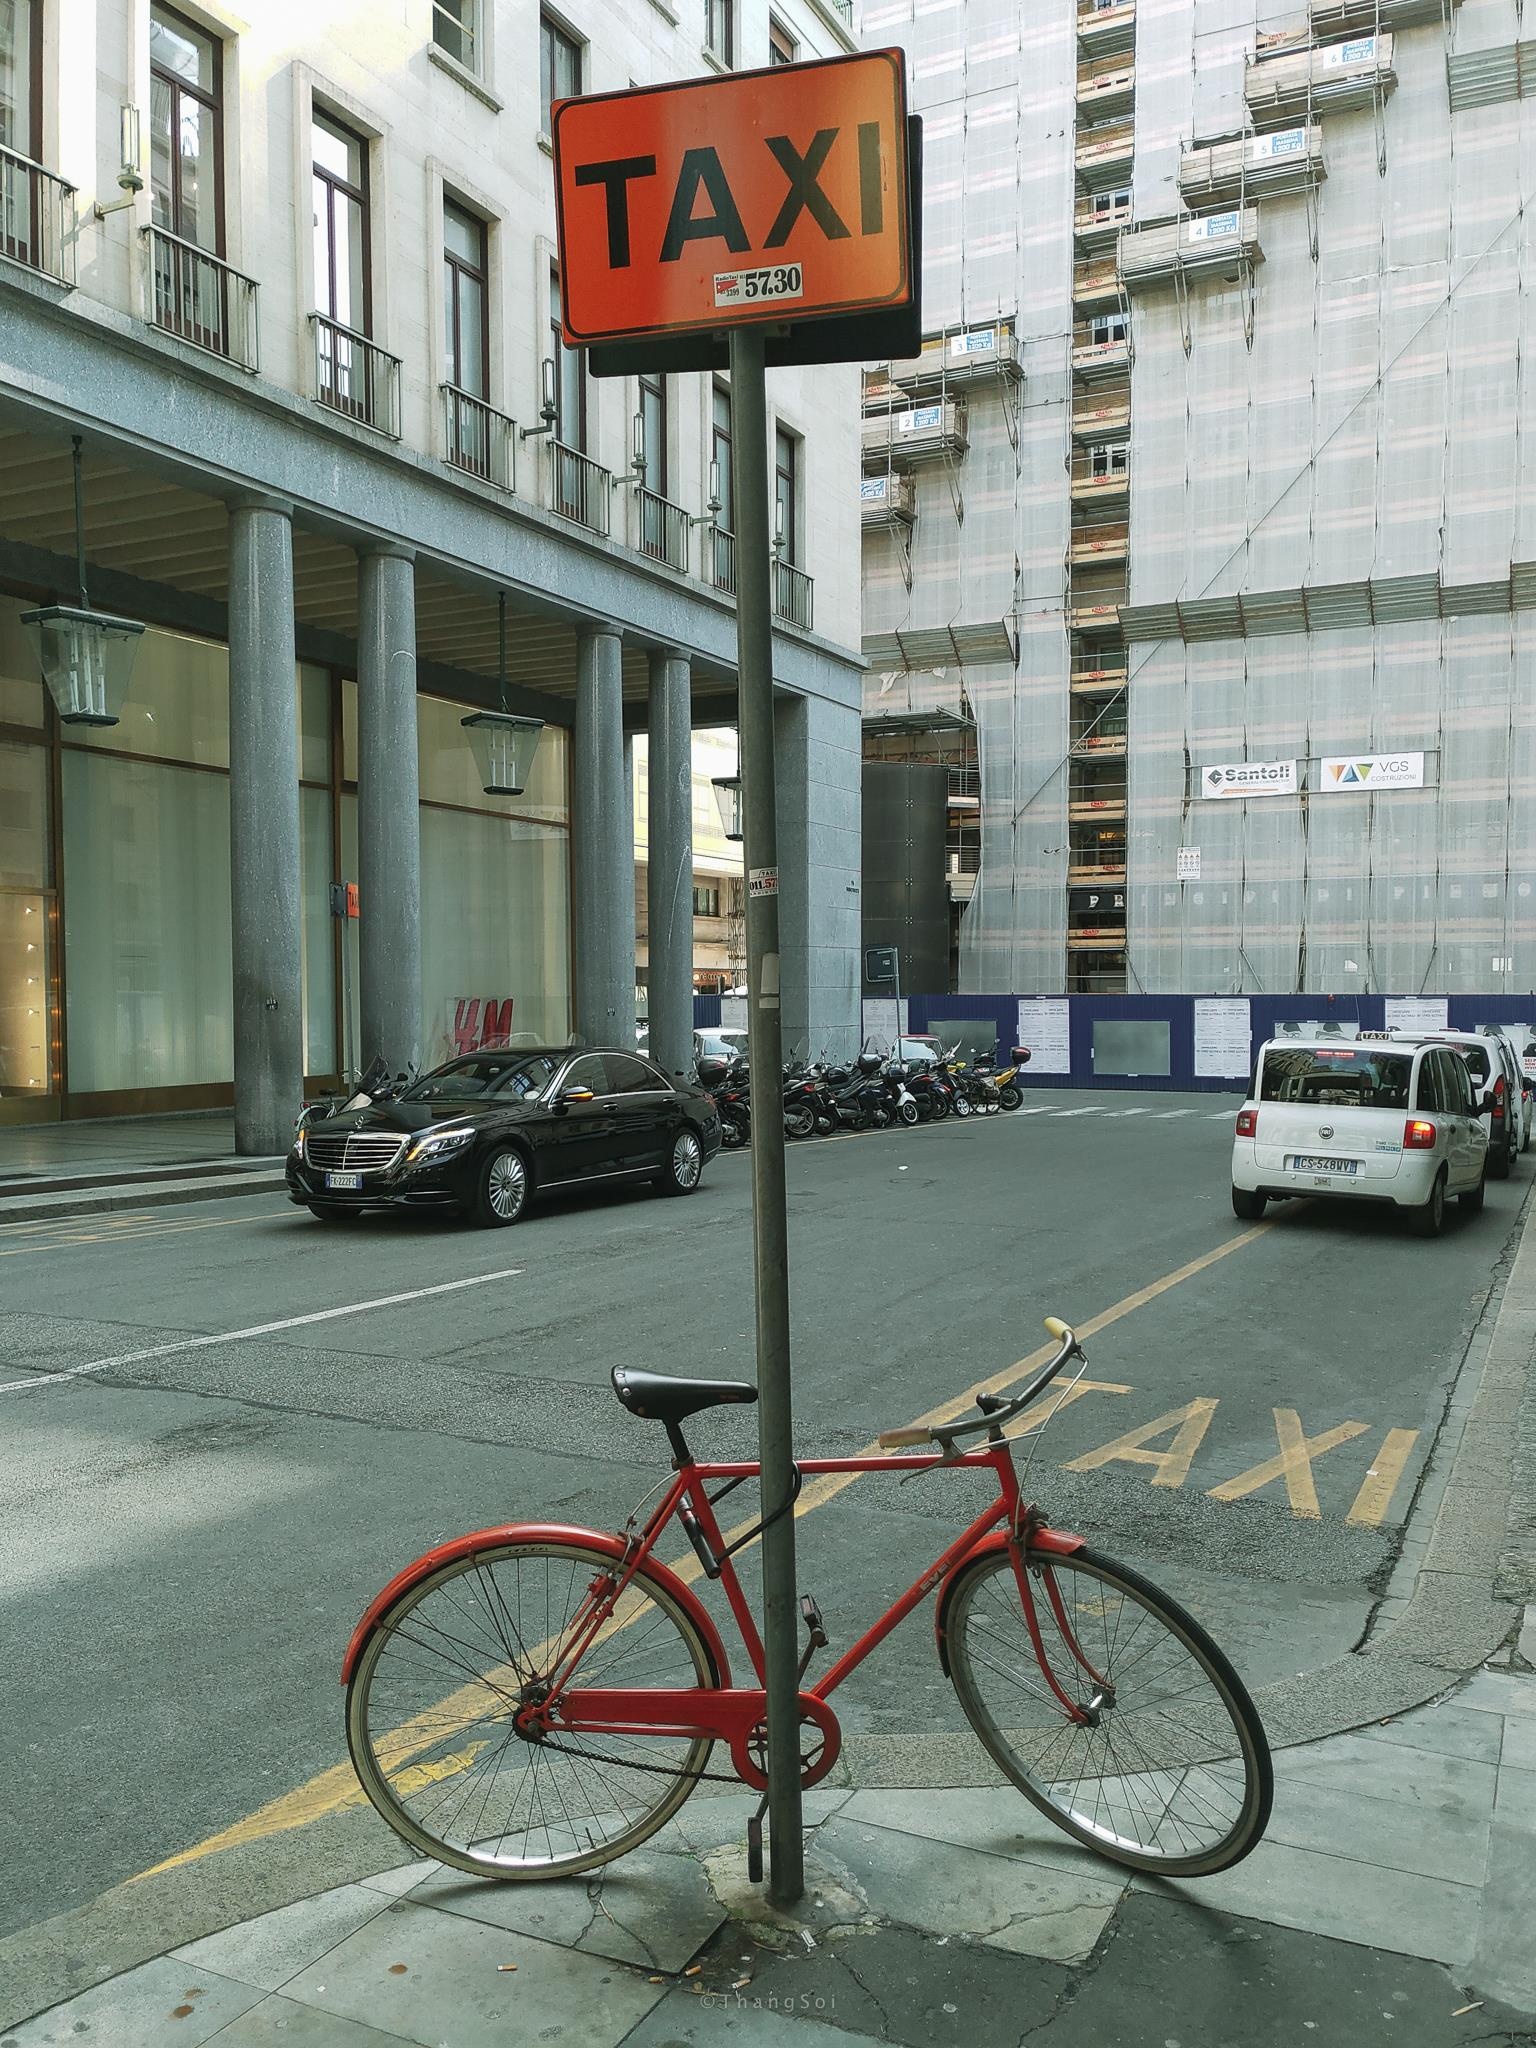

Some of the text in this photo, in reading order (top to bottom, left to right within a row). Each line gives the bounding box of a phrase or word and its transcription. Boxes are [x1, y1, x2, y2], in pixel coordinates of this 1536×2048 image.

[575, 120, 884, 270] TAXI
[745, 266, 801, 297] 57.30
[1225, 765, 1290, 781] Santoli
[1379, 761, 1409, 773] VGS
[1371, 774, 1417, 782] COSTRUZIONI
[750, 878, 778, 890] 011.57
[1363, 1032, 1389, 1040] TAXI
[970, 1376, 1420, 1528] TAXI
